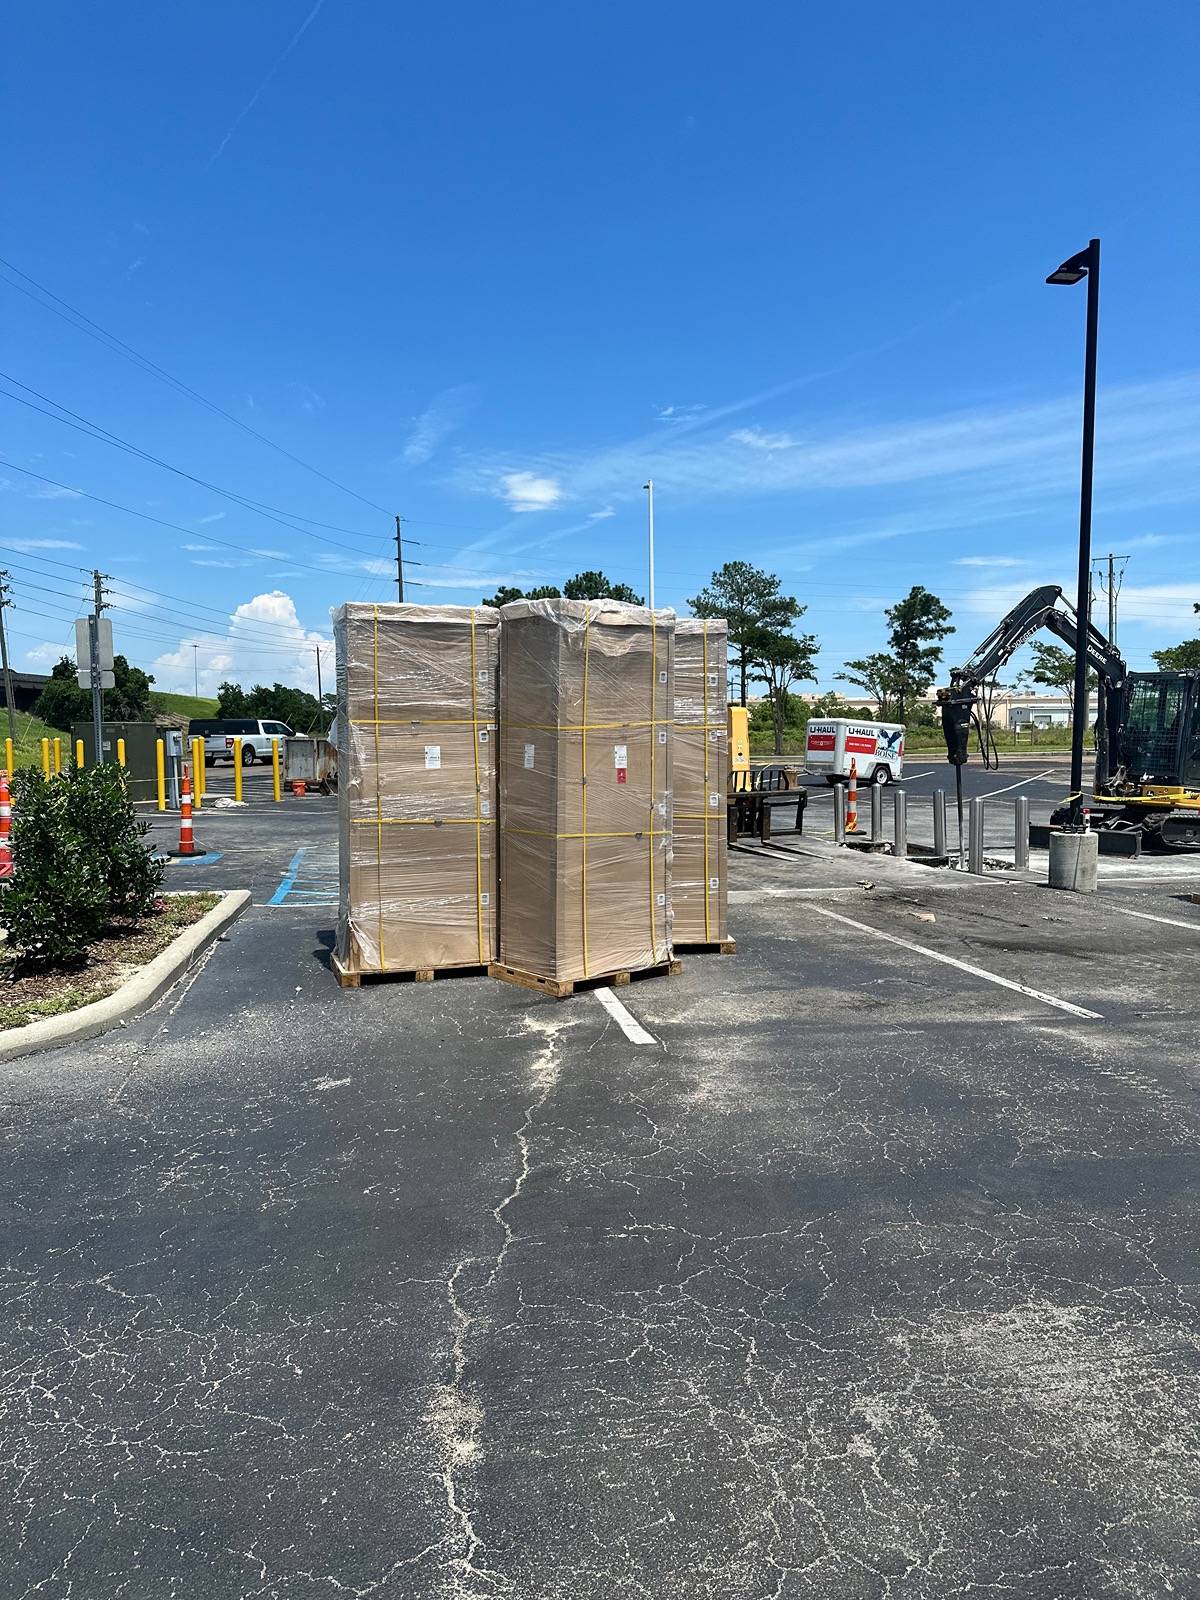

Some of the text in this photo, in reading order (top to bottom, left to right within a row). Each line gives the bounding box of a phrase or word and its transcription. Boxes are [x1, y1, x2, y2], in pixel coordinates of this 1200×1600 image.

[1086, 644, 1107, 664] DEERE
[848, 727, 875, 736] U-HAUL
[874, 749, 896, 760] BOISE
